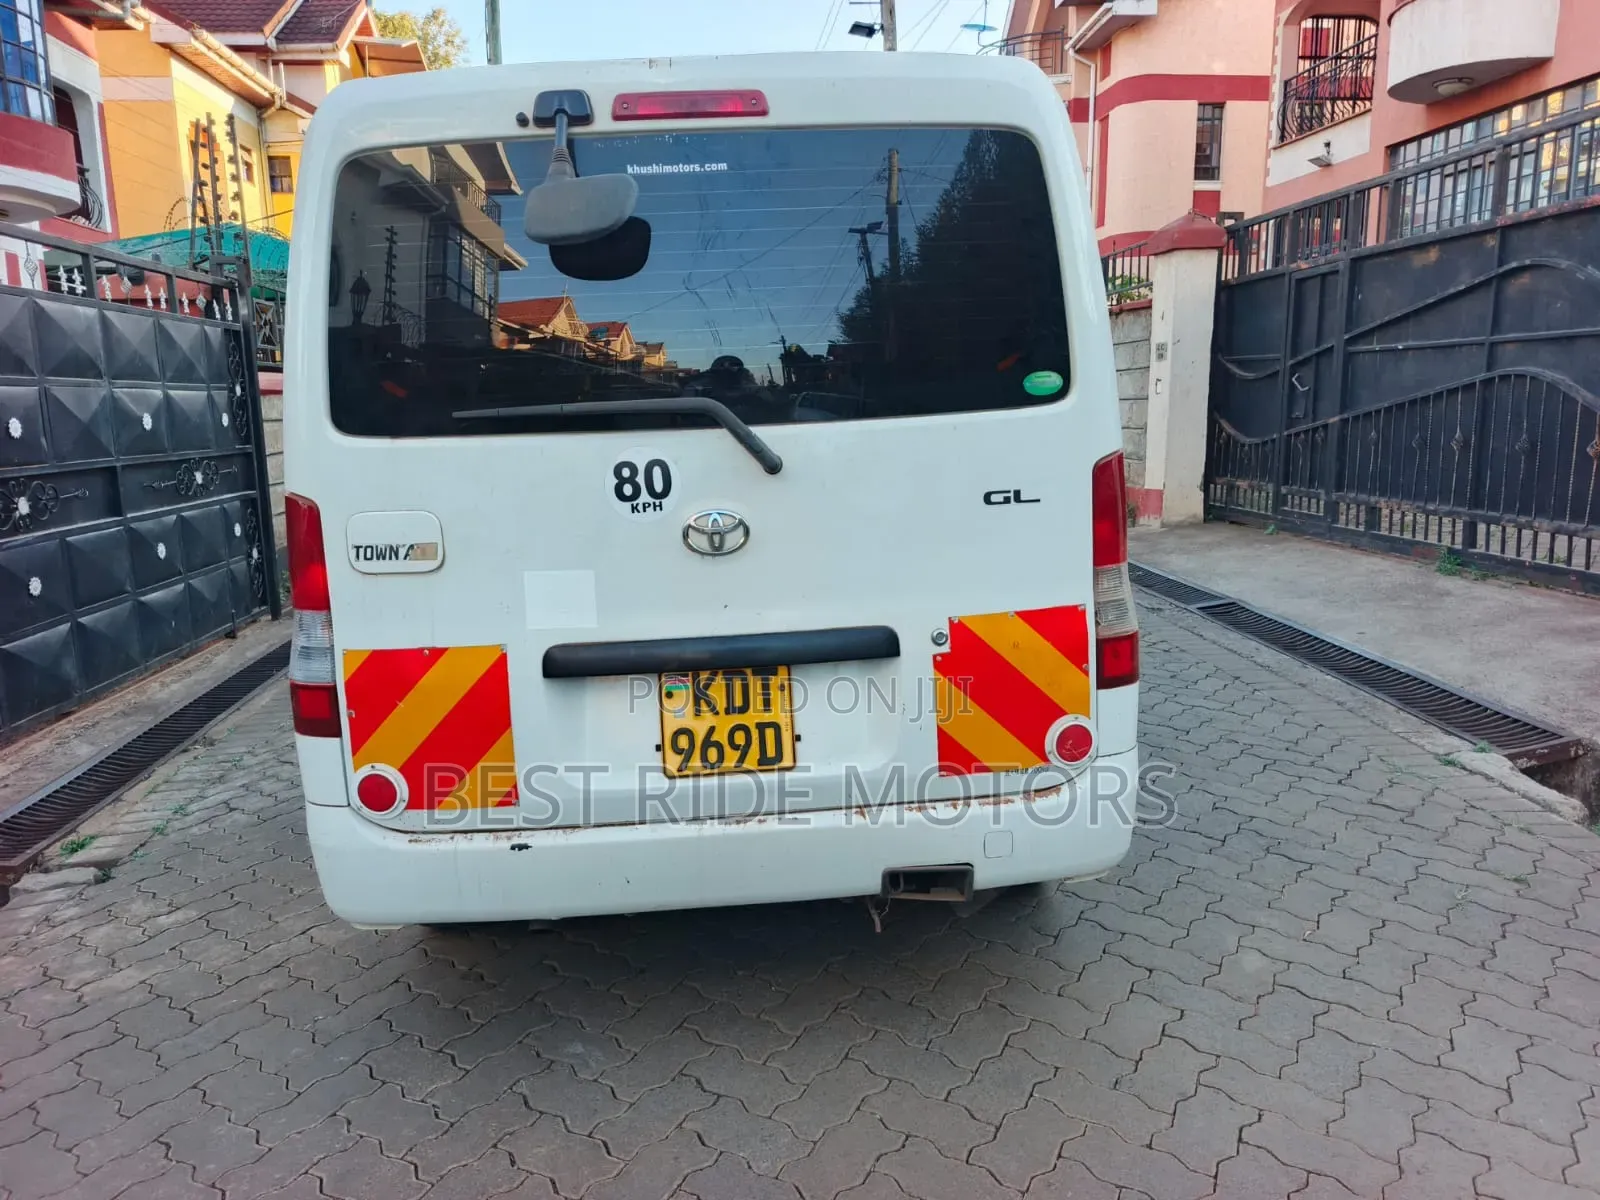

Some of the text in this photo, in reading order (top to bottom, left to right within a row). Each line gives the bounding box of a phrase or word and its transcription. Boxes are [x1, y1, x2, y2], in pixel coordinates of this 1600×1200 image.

[626, 162, 728, 174] khushimotors.com
[613, 458, 672, 502] 80
[630, 501, 663, 514] KPH
[983, 489, 1041, 506] GL
[692, 667, 778, 716] KDT
[670, 721, 784, 773] 969D
